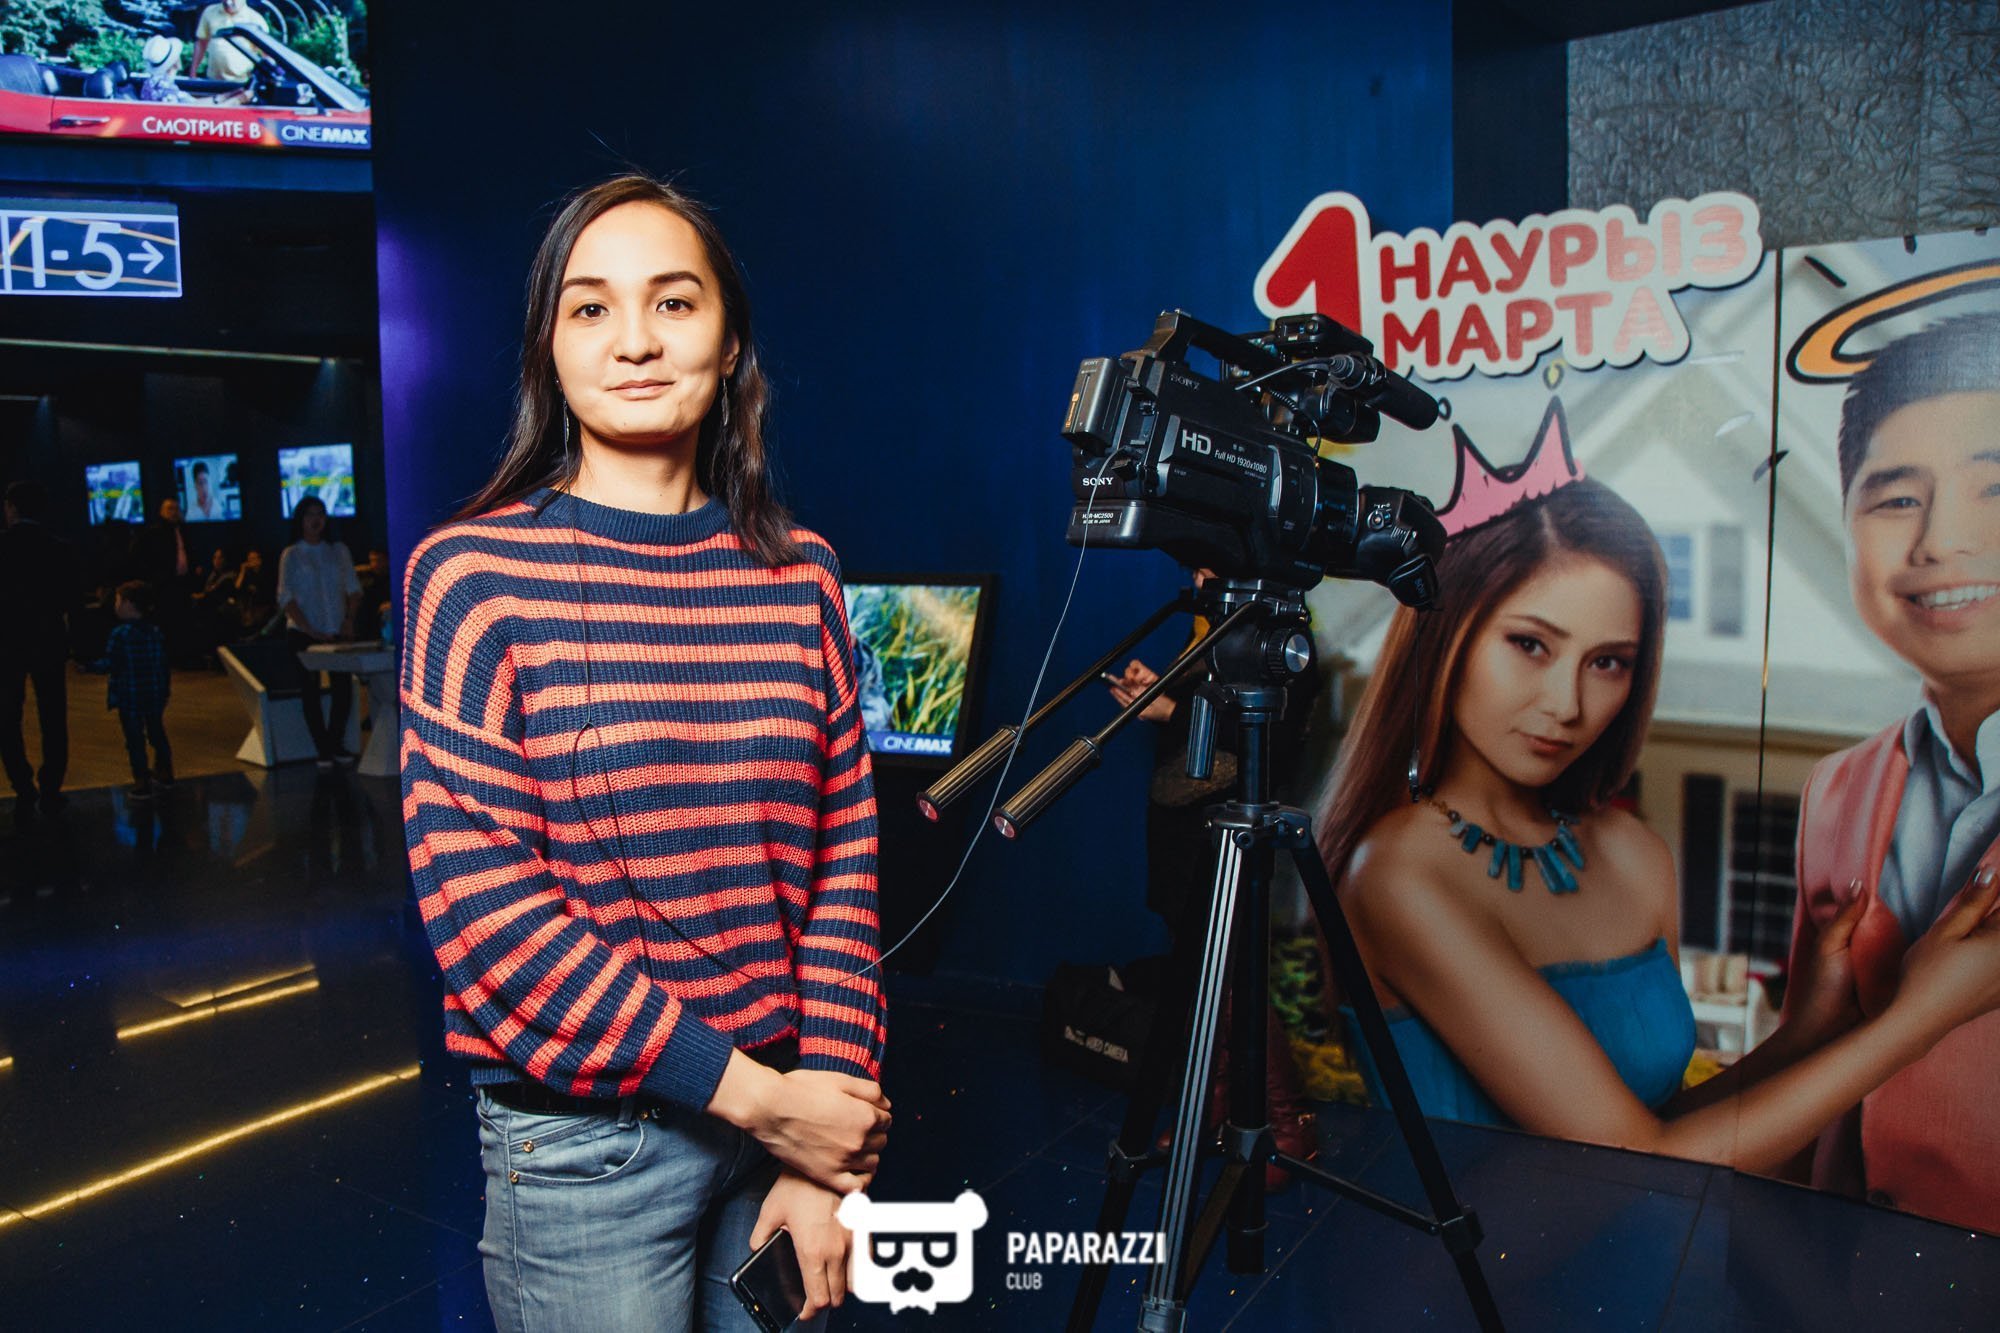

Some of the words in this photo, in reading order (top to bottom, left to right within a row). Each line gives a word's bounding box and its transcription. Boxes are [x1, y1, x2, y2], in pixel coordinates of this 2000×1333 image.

[142, 116, 244, 138] СМОТРИТЕ
[248, 121, 261, 139] В
[281, 124, 368, 145] CINEMAX
[19, 220, 124, 291] 1-5
[1266, 205, 1362, 338] 1
[1380, 205, 1748, 304] НАУРЫЗ
[1382, 285, 1675, 371] МАРТА
[1181, 429, 1212, 455] HD
[1215, 449, 1226, 460] Full
[1226, 453, 1236, 464] HD
[1236, 457, 1267, 474] 1920x1080
[1082, 476, 1114, 487] SONY
[883, 736, 953, 753] CINEMAX
